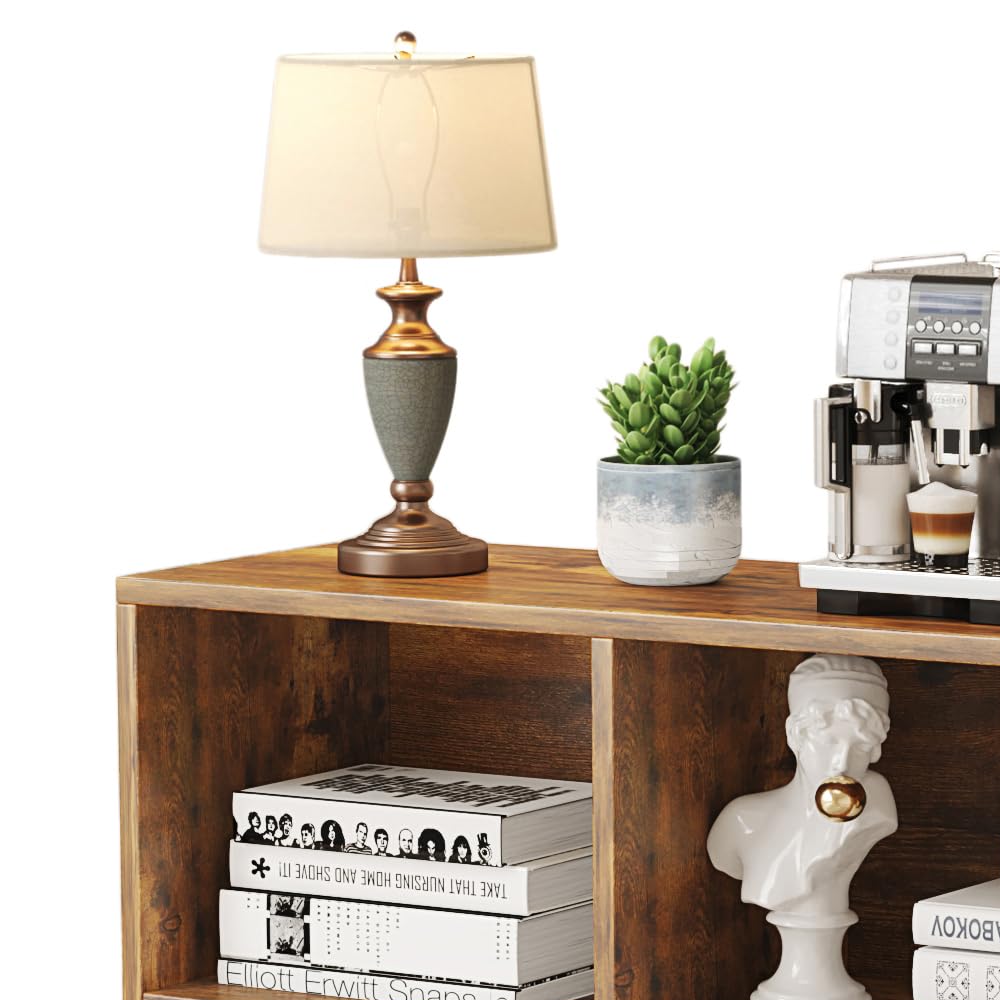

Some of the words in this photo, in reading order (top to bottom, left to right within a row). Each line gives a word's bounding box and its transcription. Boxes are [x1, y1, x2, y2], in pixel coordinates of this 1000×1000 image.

[278, 861, 292, 878] IT!
[294, 863, 331, 881] SHOVE
[334, 866, 357, 884] AND
[361, 869, 392, 887] HOME
[395, 873, 445, 893] NURSING
[448, 878, 476, 896] THAT
[480, 882, 508, 900] TAKE
[225, 960, 294, 991] Elliott
[304, 968, 379, 998] Erwitt
